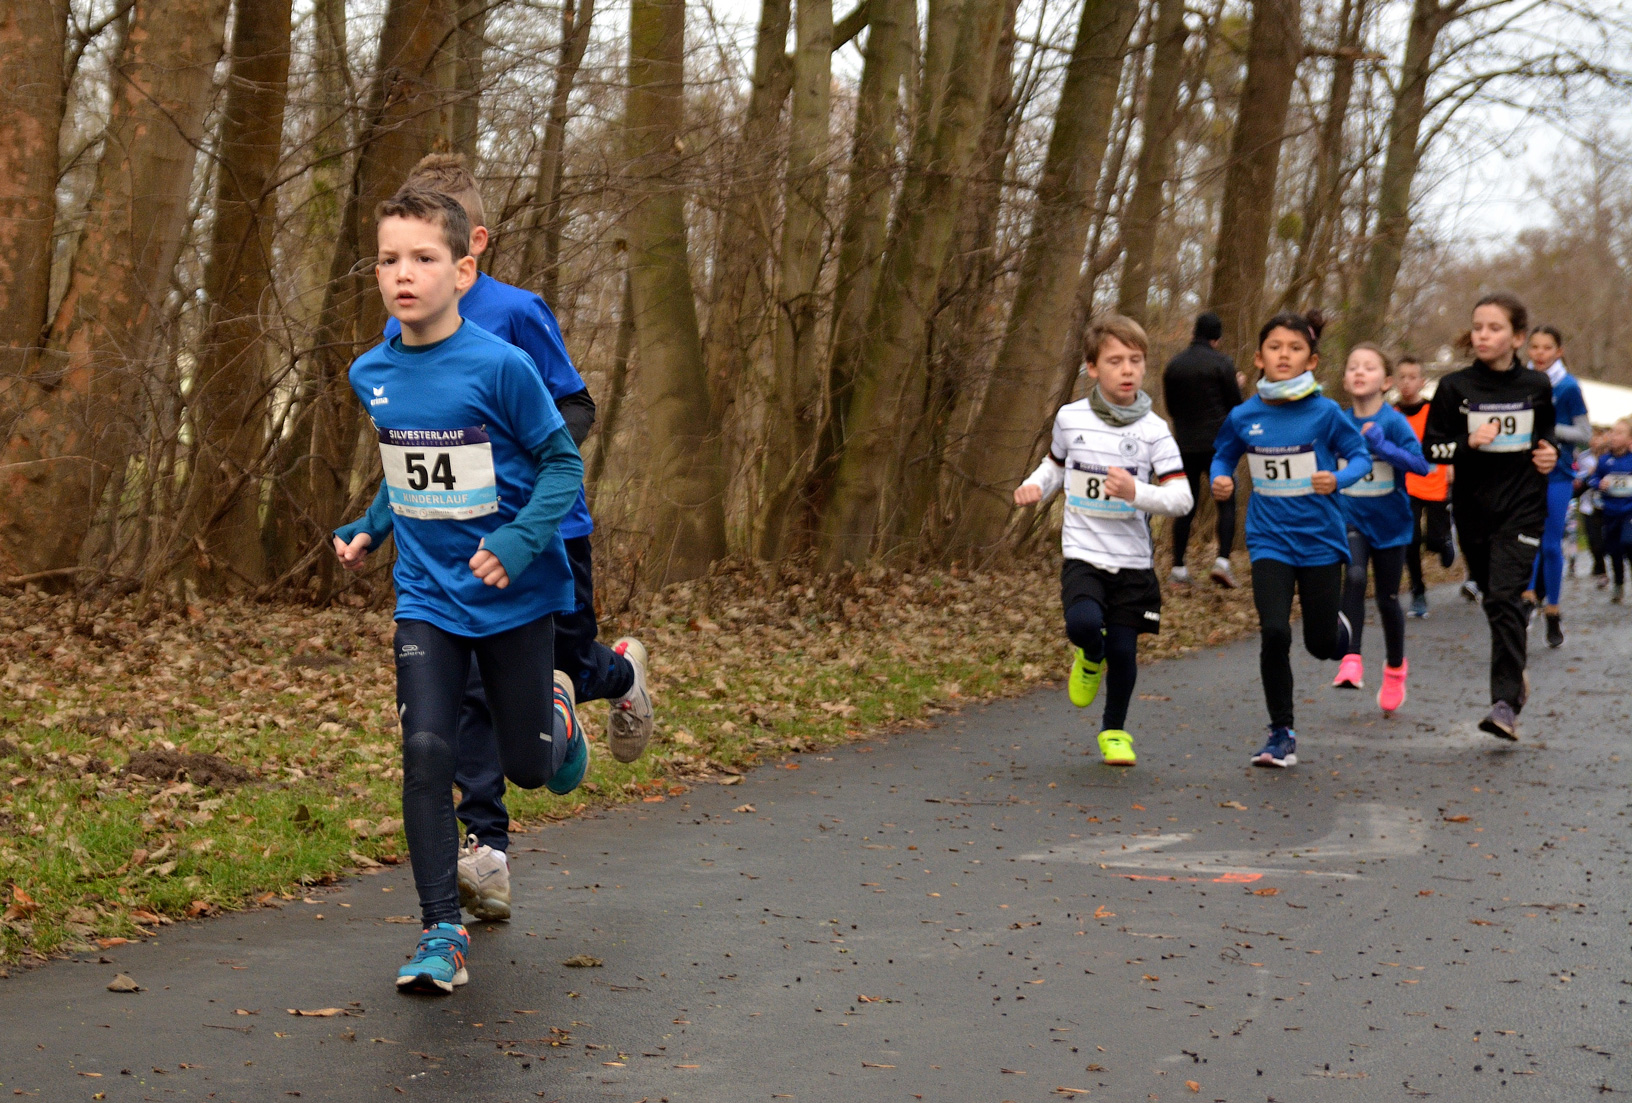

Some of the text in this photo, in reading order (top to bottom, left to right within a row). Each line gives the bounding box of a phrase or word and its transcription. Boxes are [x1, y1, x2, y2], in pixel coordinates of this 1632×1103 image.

[389, 430, 464, 440] SILVESTERLAUF
[404, 452, 456, 490] 54
[1264, 459, 1292, 480] 51
[403, 492, 468, 504] KINDERLAUF
